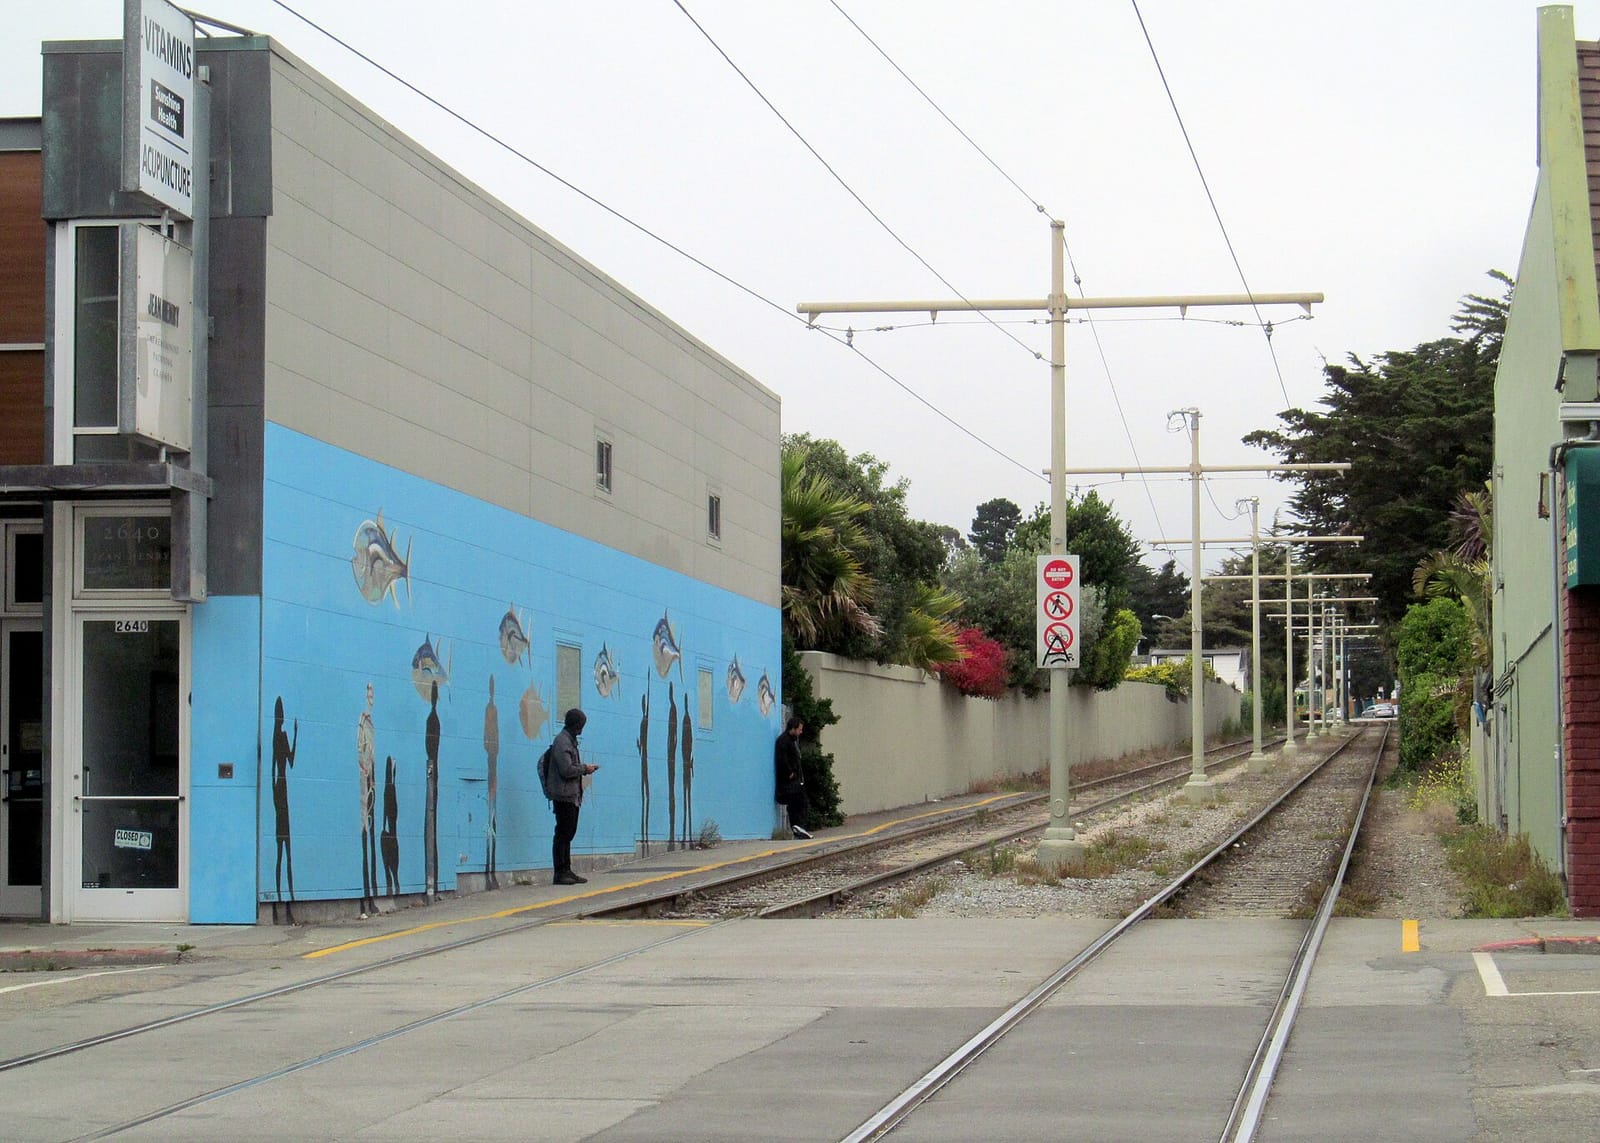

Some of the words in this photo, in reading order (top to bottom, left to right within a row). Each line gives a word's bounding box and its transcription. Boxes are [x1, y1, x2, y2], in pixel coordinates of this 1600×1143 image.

[144, 15, 192, 80] VITAMINS
[155, 85, 181, 114] Sunshine
[157, 107, 178, 130] Health
[142, 144, 191, 198] ACUPUNCTURE
[104, 526, 159, 543] 2640
[116, 620, 148, 632] 2640
[116, 831, 139, 841] CLOSED
